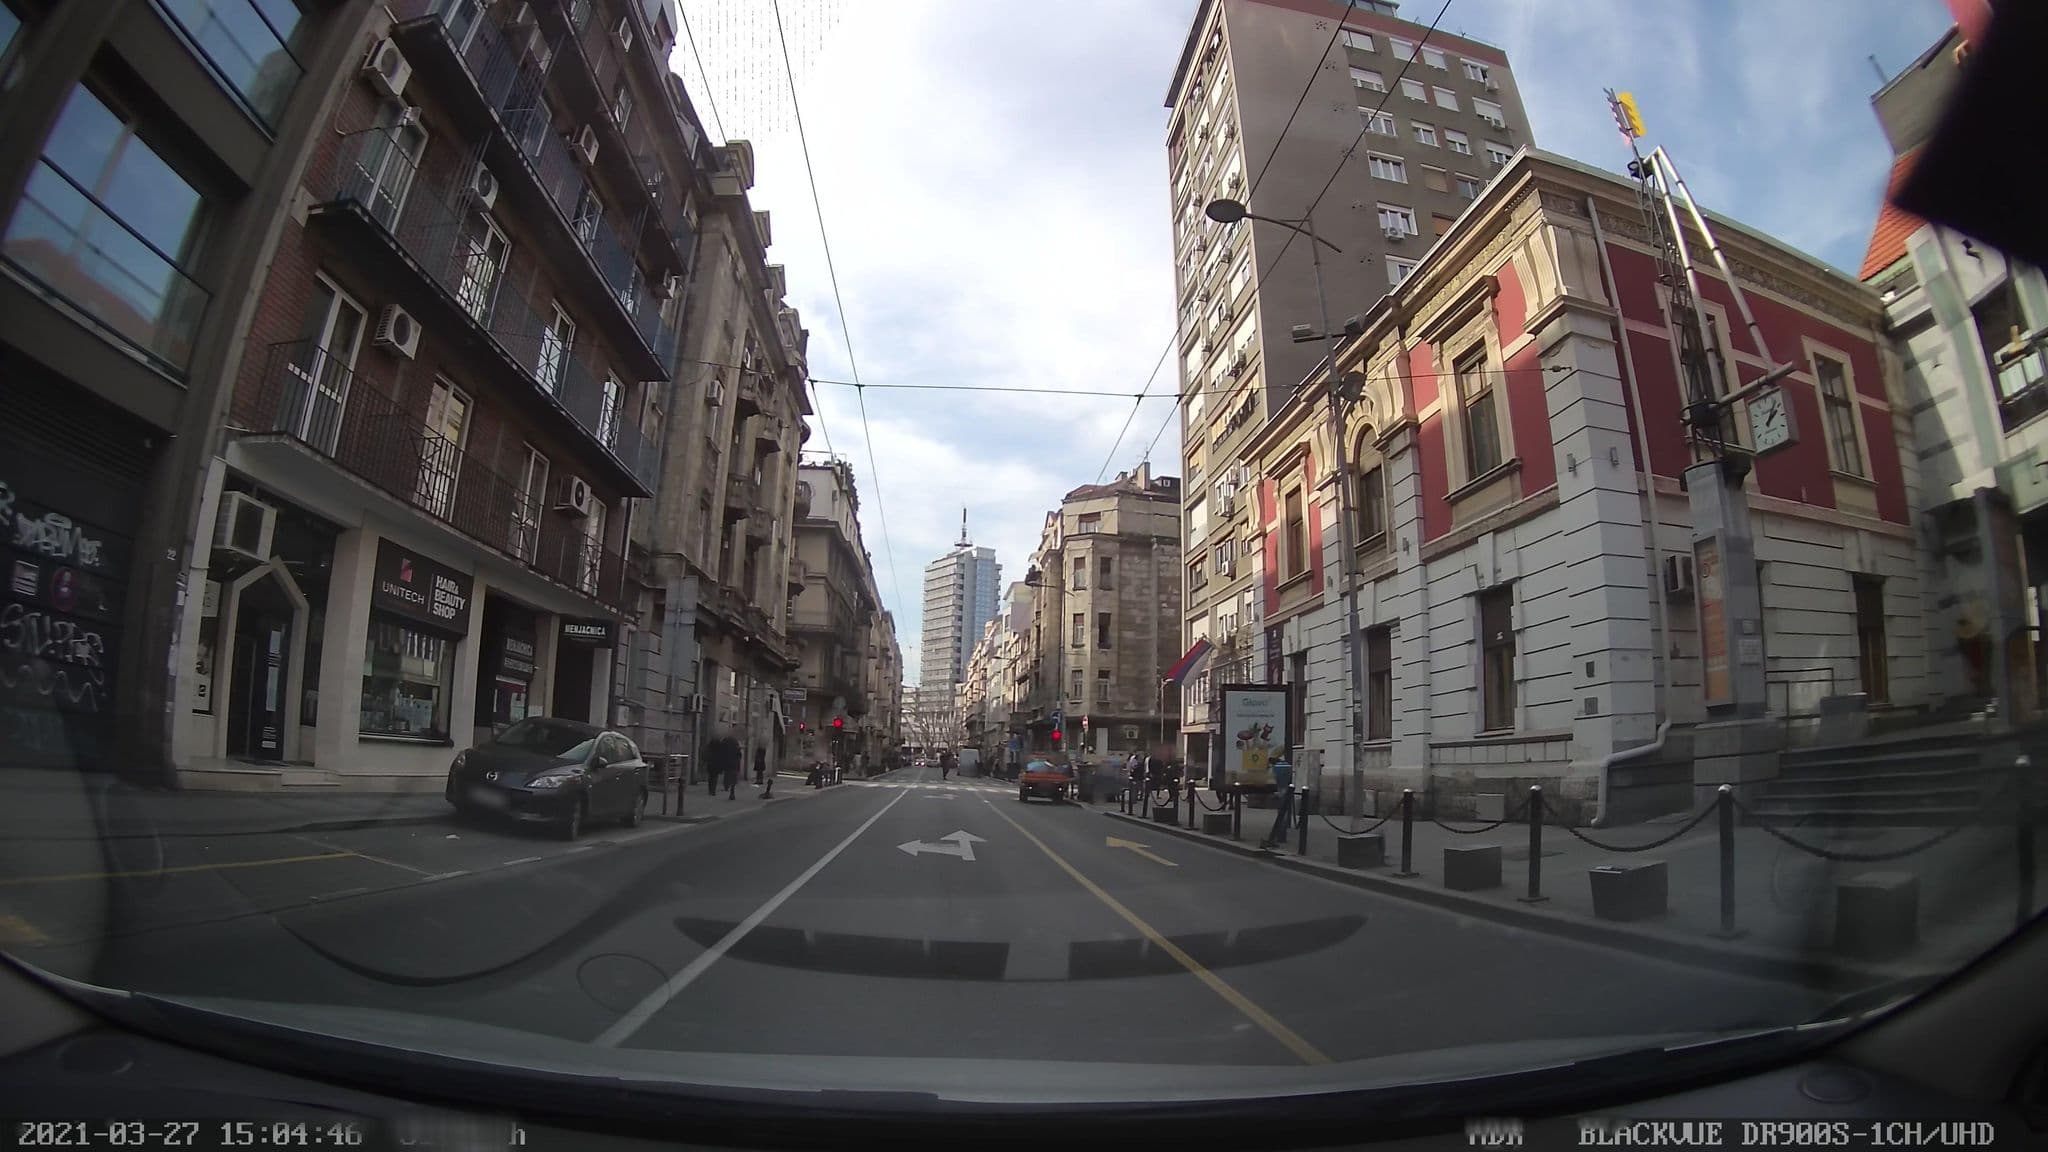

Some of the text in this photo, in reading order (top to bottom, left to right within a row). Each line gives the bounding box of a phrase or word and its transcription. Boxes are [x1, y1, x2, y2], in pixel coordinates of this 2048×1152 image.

[382, 580, 425, 605] UNITECH
[434, 588, 466, 610] BEAUTY
[432, 602, 456, 620] SHOP
